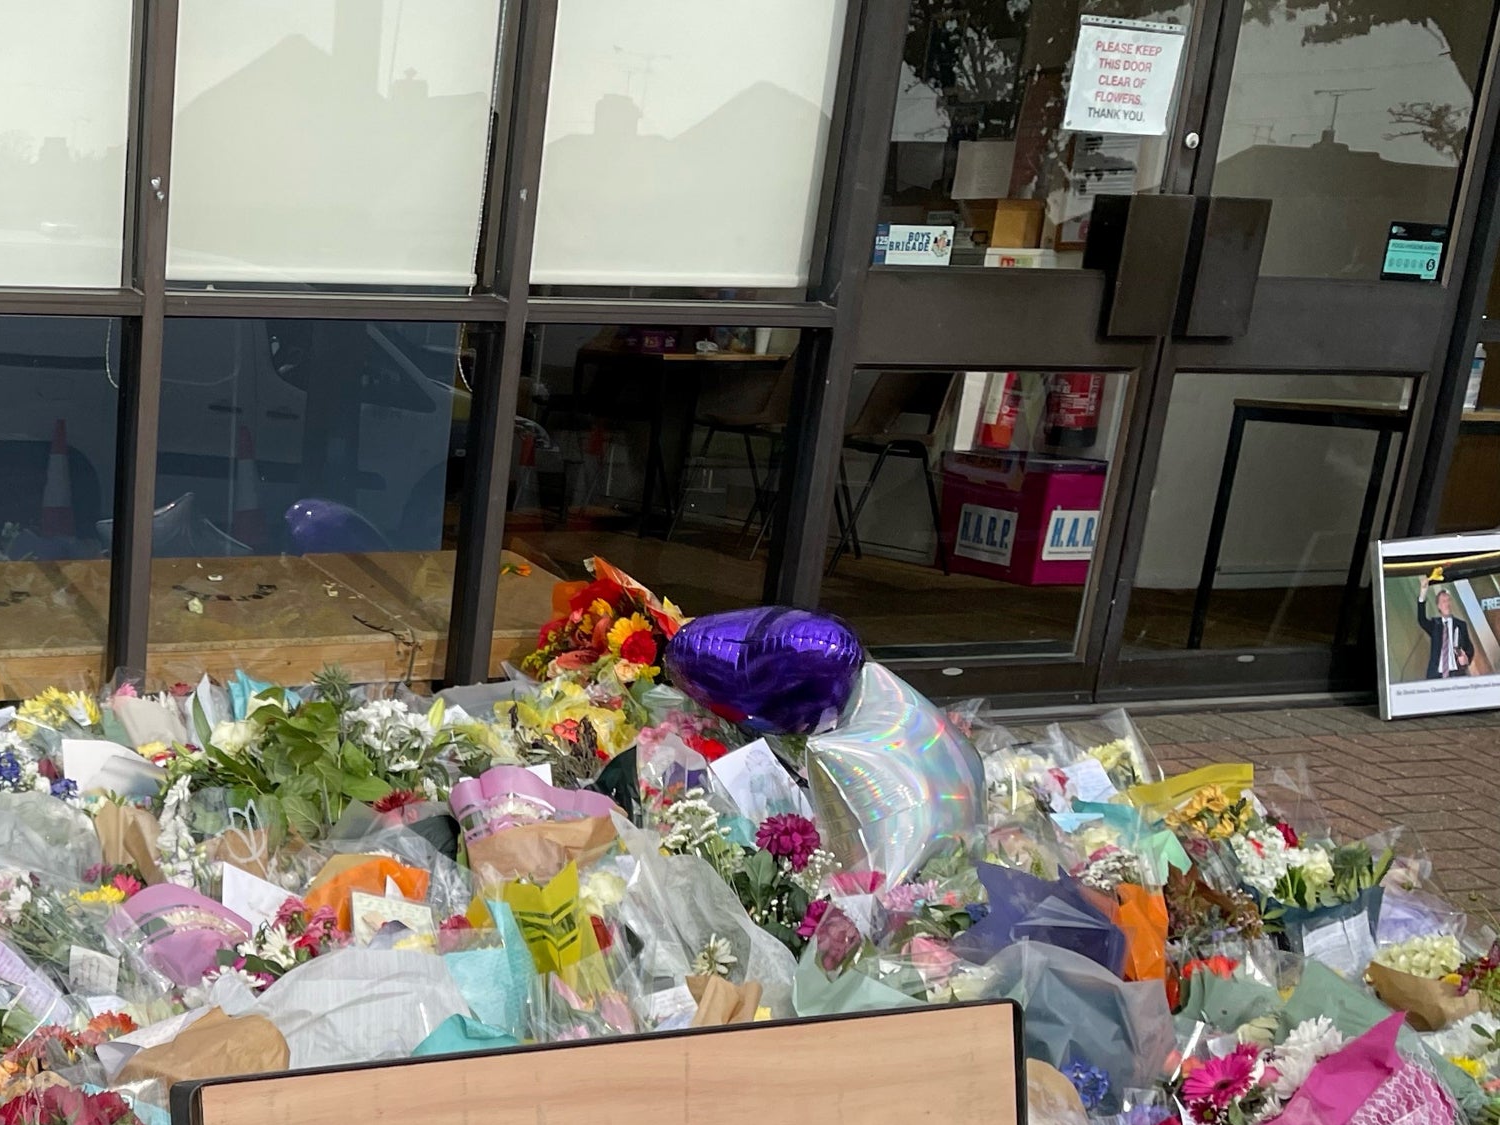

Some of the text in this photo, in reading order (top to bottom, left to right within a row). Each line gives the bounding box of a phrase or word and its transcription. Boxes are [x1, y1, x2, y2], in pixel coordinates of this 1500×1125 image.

[1096, 41, 1162, 56] PLEASE KEEP
[1099, 58, 1152, 72] THIS DOOR
[1098, 74, 1147, 88] CLEAR OF
[1088, 107, 1120, 120] THANK
[908, 232, 931, 243] BOYS
[888, 241, 930, 252] BRIGADE
[960, 511, 1011, 549] H.A.R.P.
